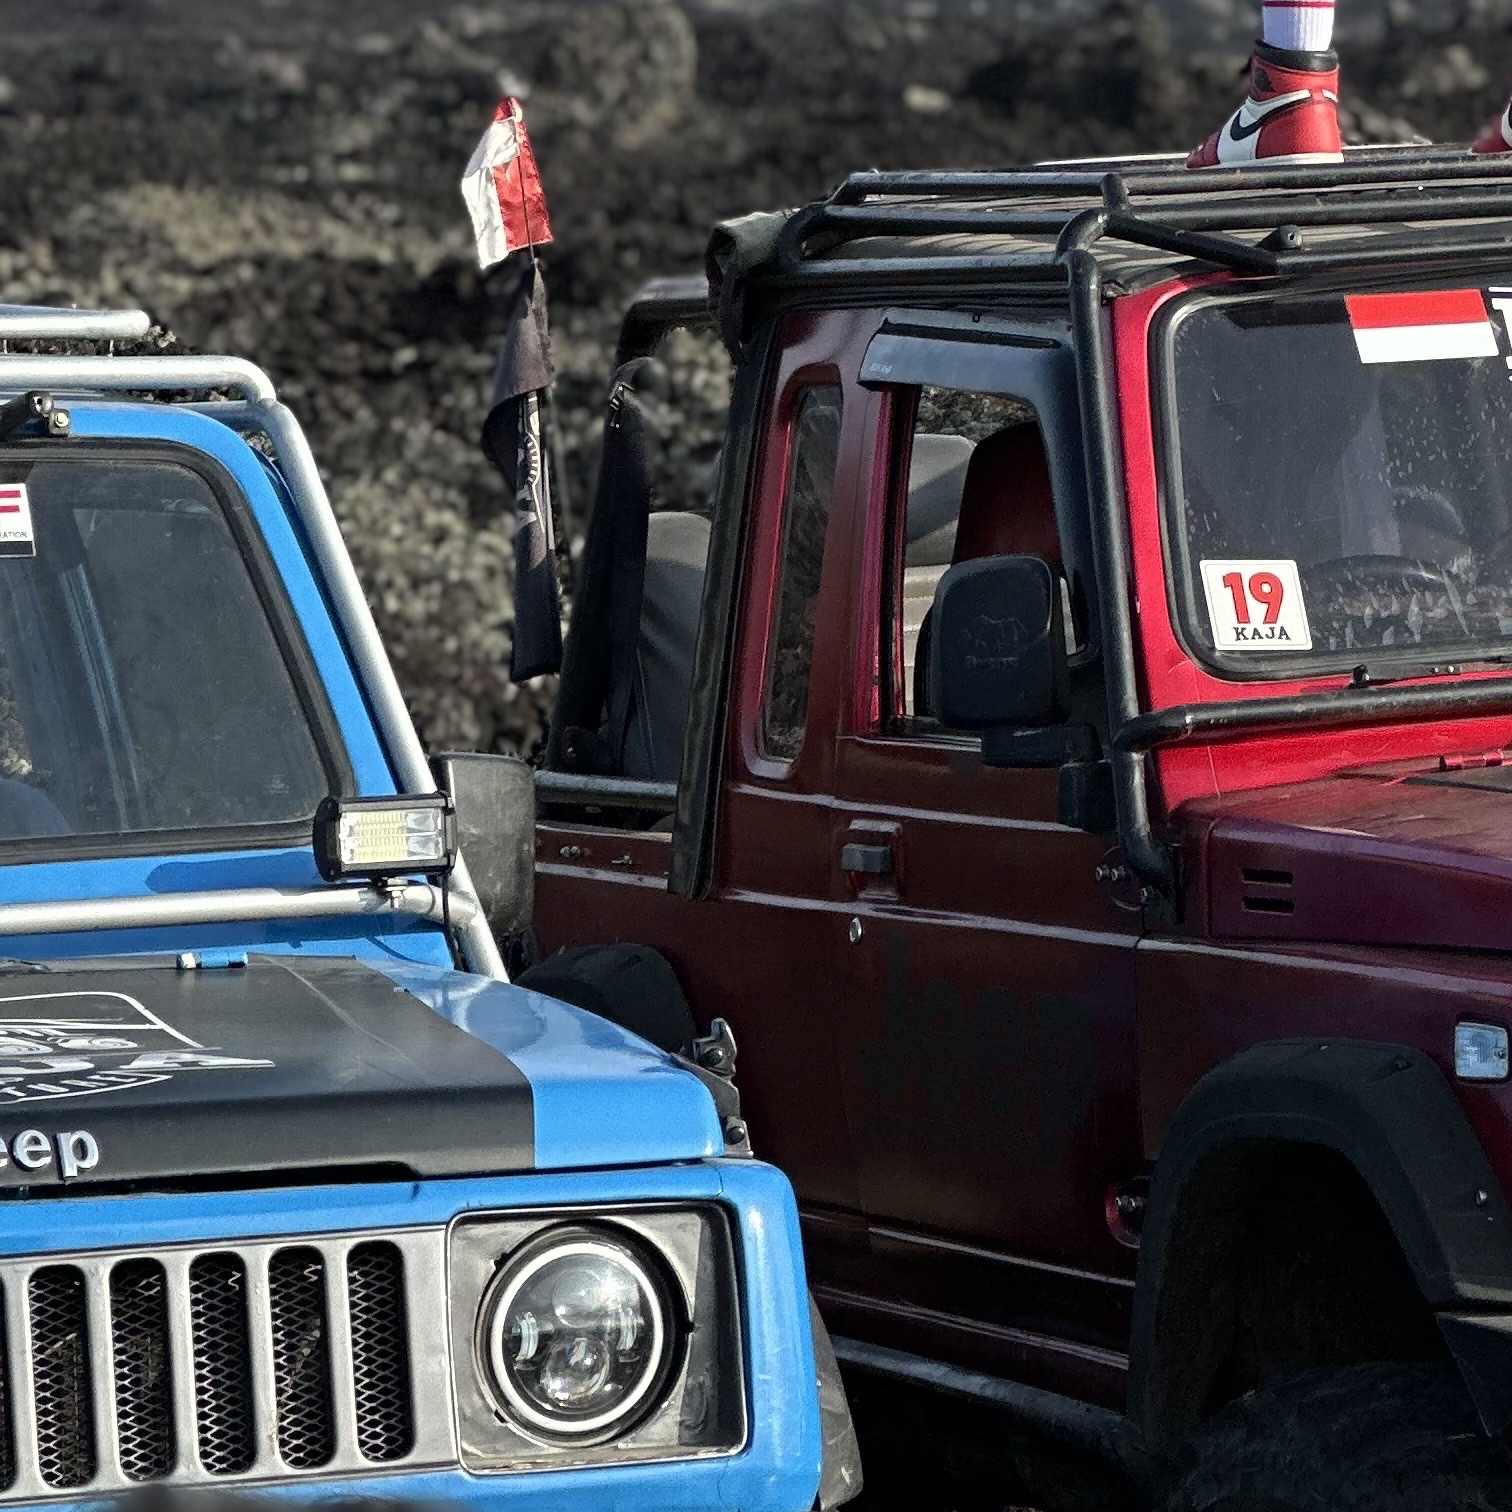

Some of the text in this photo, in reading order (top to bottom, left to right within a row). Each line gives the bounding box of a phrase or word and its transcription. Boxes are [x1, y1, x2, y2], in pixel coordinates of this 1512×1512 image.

[1222, 572, 1284, 624] 19
[1233, 626, 1292, 641] KAJA
[0, 1129, 99, 1178] ep
